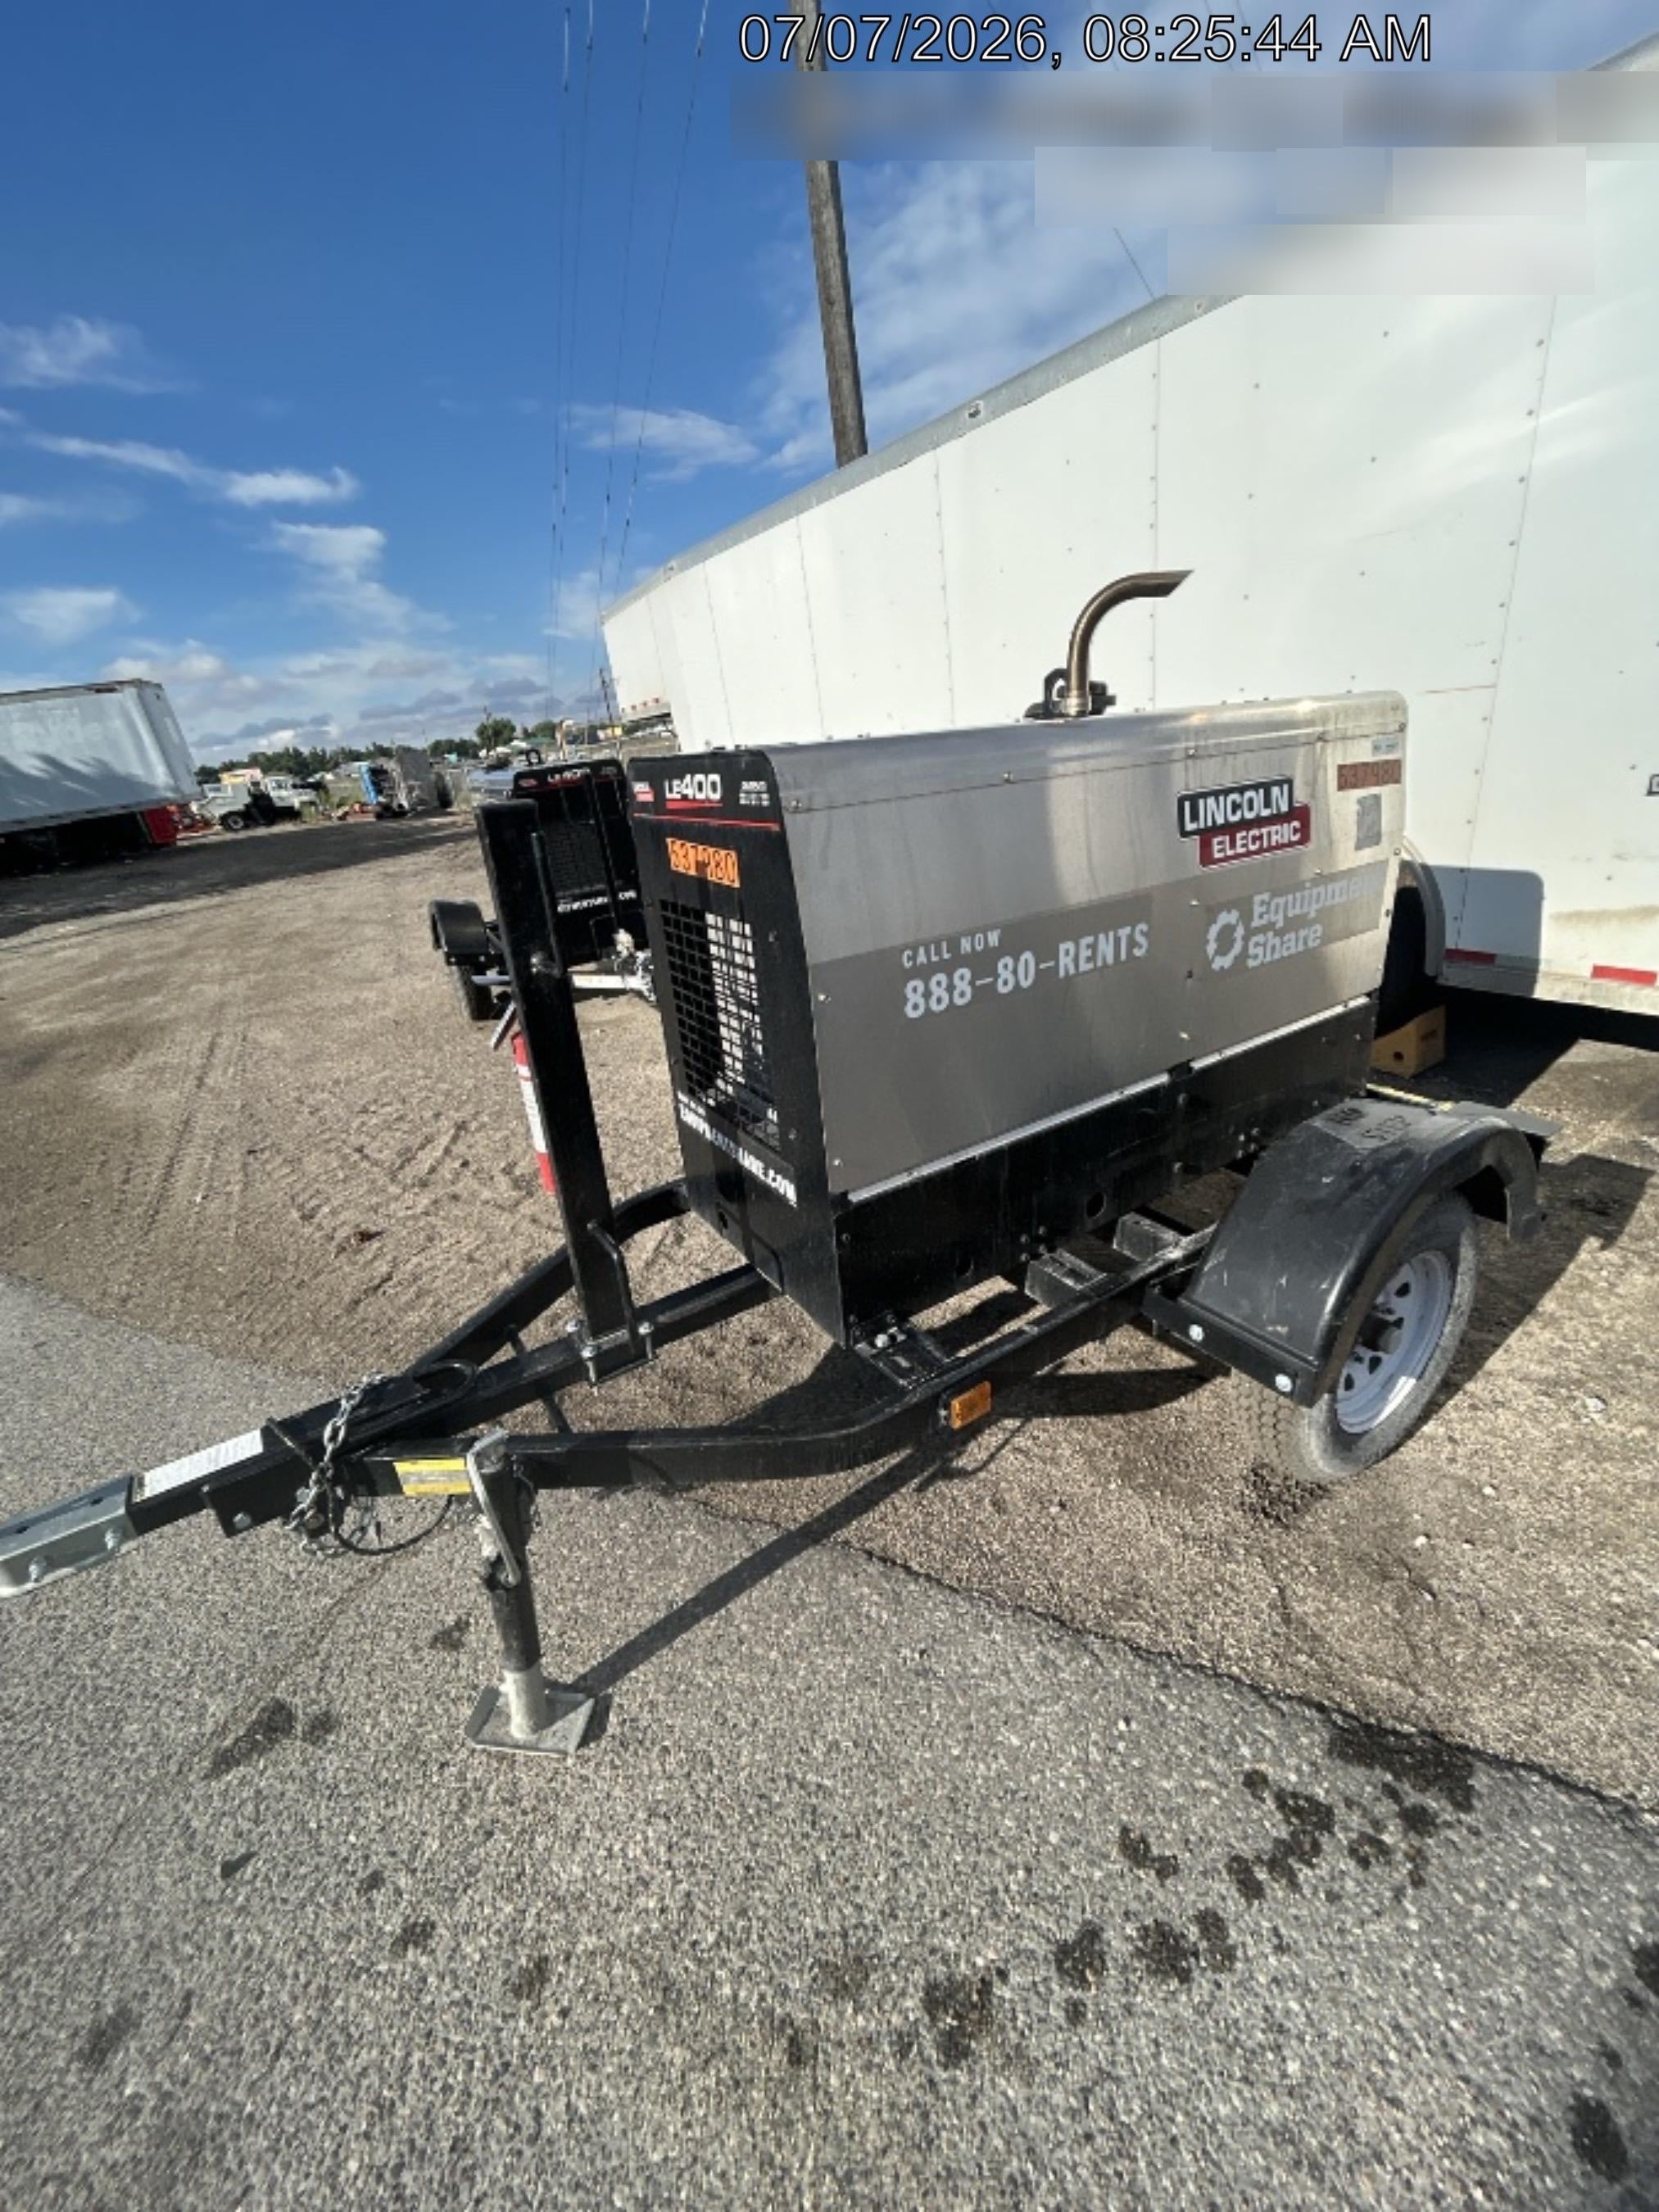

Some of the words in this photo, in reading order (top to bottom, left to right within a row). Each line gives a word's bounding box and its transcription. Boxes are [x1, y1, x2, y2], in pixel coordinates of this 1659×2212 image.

[664, 773, 721, 800] LE400
[1184, 783, 1290, 832] LINCOLN
[1213, 820, 1301, 859] ELECTRIC
[902, 941, 952, 969] CALL
[960, 928, 1002, 954] NOW
[1246, 923, 1323, 969] Share
[904, 921, 1149, 1019] 888-80-RENTS
